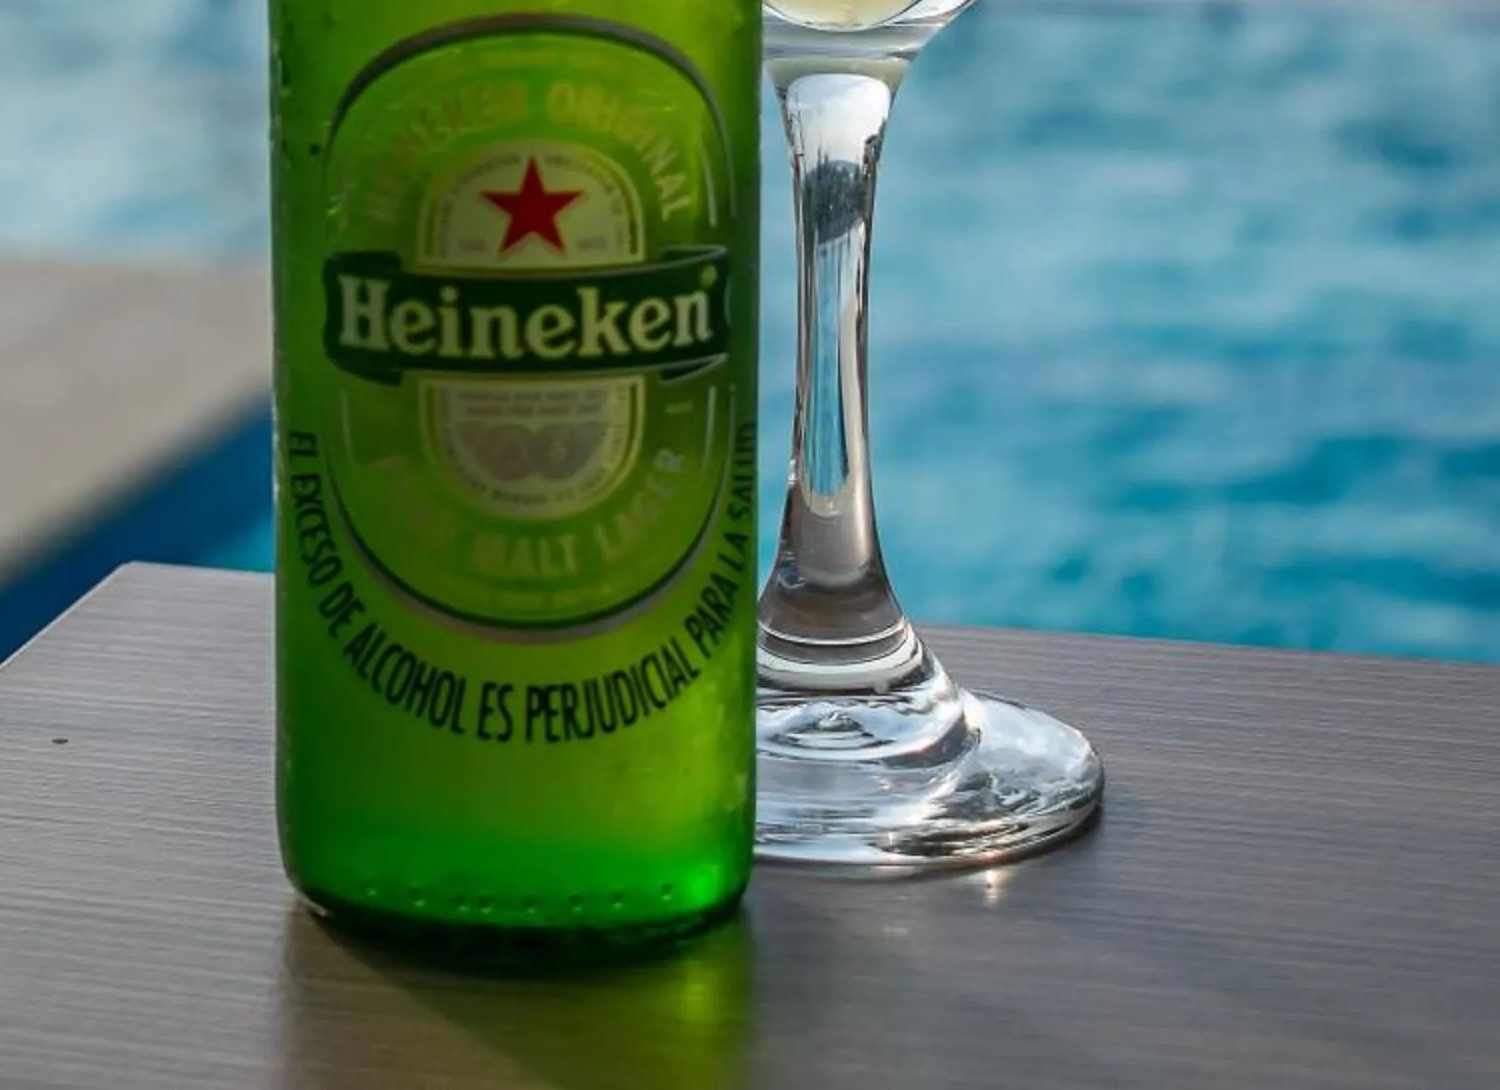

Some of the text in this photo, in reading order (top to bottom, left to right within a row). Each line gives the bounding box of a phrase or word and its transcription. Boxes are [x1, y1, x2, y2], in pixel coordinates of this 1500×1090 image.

[544, 79, 693, 223] ORIGINAL
[337, 273, 713, 359] Heineken
[289, 429, 318, 458] EL
[290, 473, 343, 586] EXCESO
[469, 531, 579, 578] MALT
[593, 447, 688, 562] LAGER
[717, 531, 751, 573] LA
[319, 581, 365, 639] DE
[683, 571, 740, 659] PARA
[342, 622, 466, 735] ALCOHOL
[476, 680, 514, 743] ES
[525, 635, 702, 743] PERJUDICIAL
